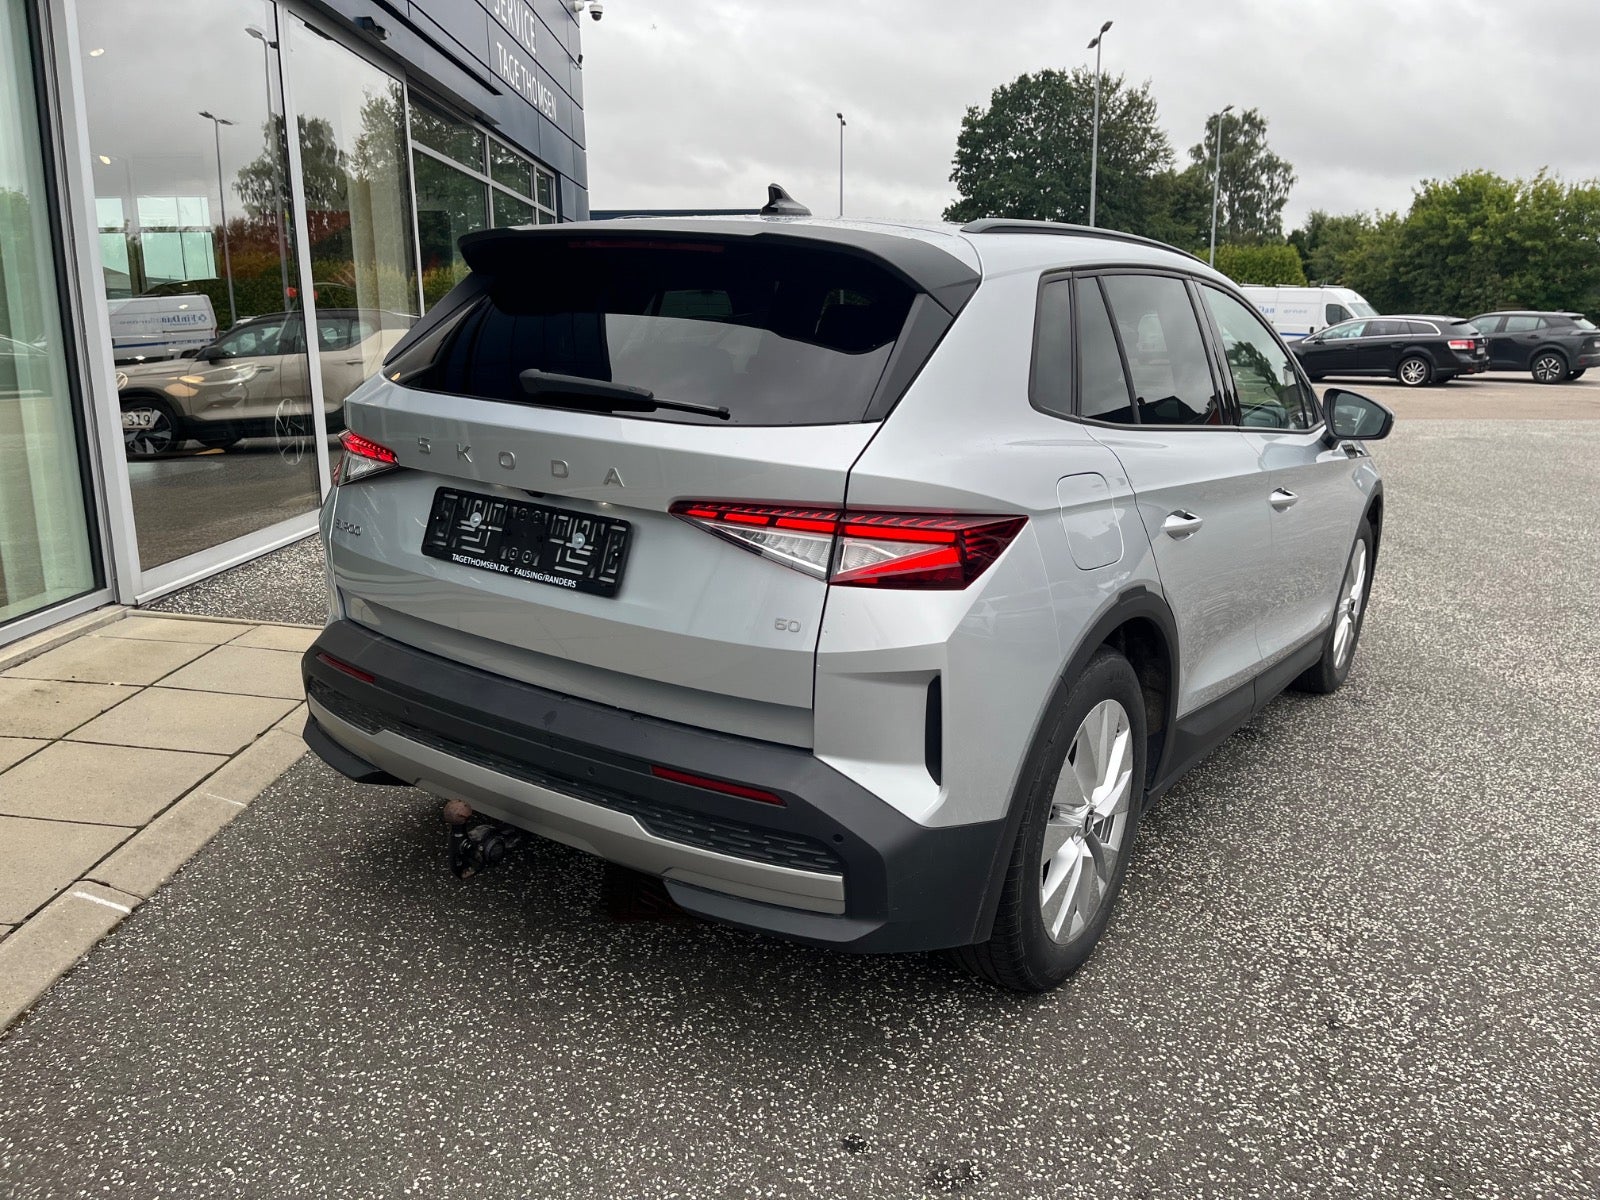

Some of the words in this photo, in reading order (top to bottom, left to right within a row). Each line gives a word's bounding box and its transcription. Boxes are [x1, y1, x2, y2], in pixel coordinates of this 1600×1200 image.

[496, 42, 521, 91] TAGE
[521, 66, 557, 122] THOMSEN
[452, 553, 509, 574] TAGETHOMSEN.DK
[514, 567, 577, 588] FAUSING/RANDERS
[774, 618, 801, 632] 60
